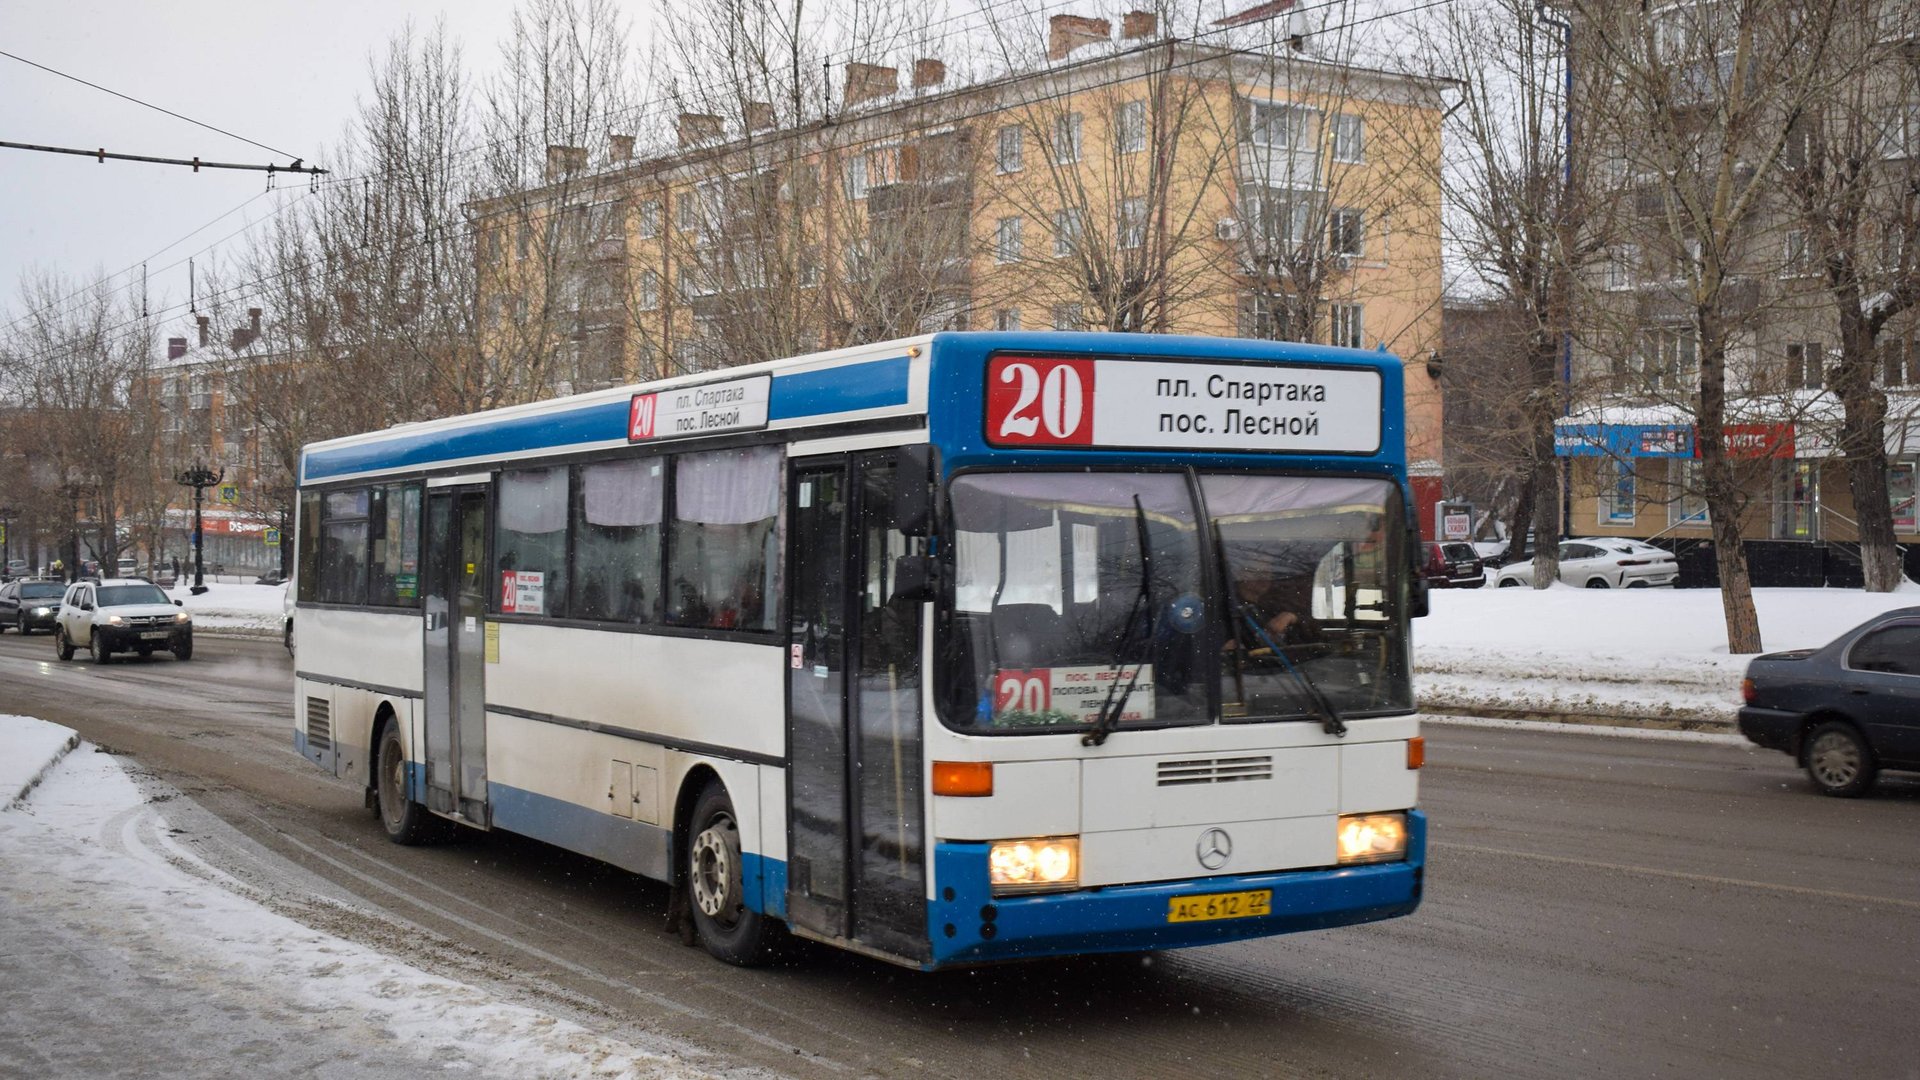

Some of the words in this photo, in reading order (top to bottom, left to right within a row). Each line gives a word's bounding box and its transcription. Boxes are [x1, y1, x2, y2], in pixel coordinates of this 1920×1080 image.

[676, 395, 692, 410] пл.
[695, 386, 745, 409] Спартака
[1000, 362, 1083, 440] 20
[1156, 377, 1196, 399] пл.
[1206, 374, 1326, 406] Спартака
[633, 397, 653, 436] 20
[676, 417, 697, 432] пос.
[700, 407, 740, 429] Лесной
[1159, 413, 1214, 434] пос.
[1223, 409, 1319, 437] Лесной
[504, 576, 516, 606] 20
[1001, 677, 1045, 716] 20
[1052, 686, 1099, 695] ПОПОВА
[1248, 893, 1265, 907] 22
